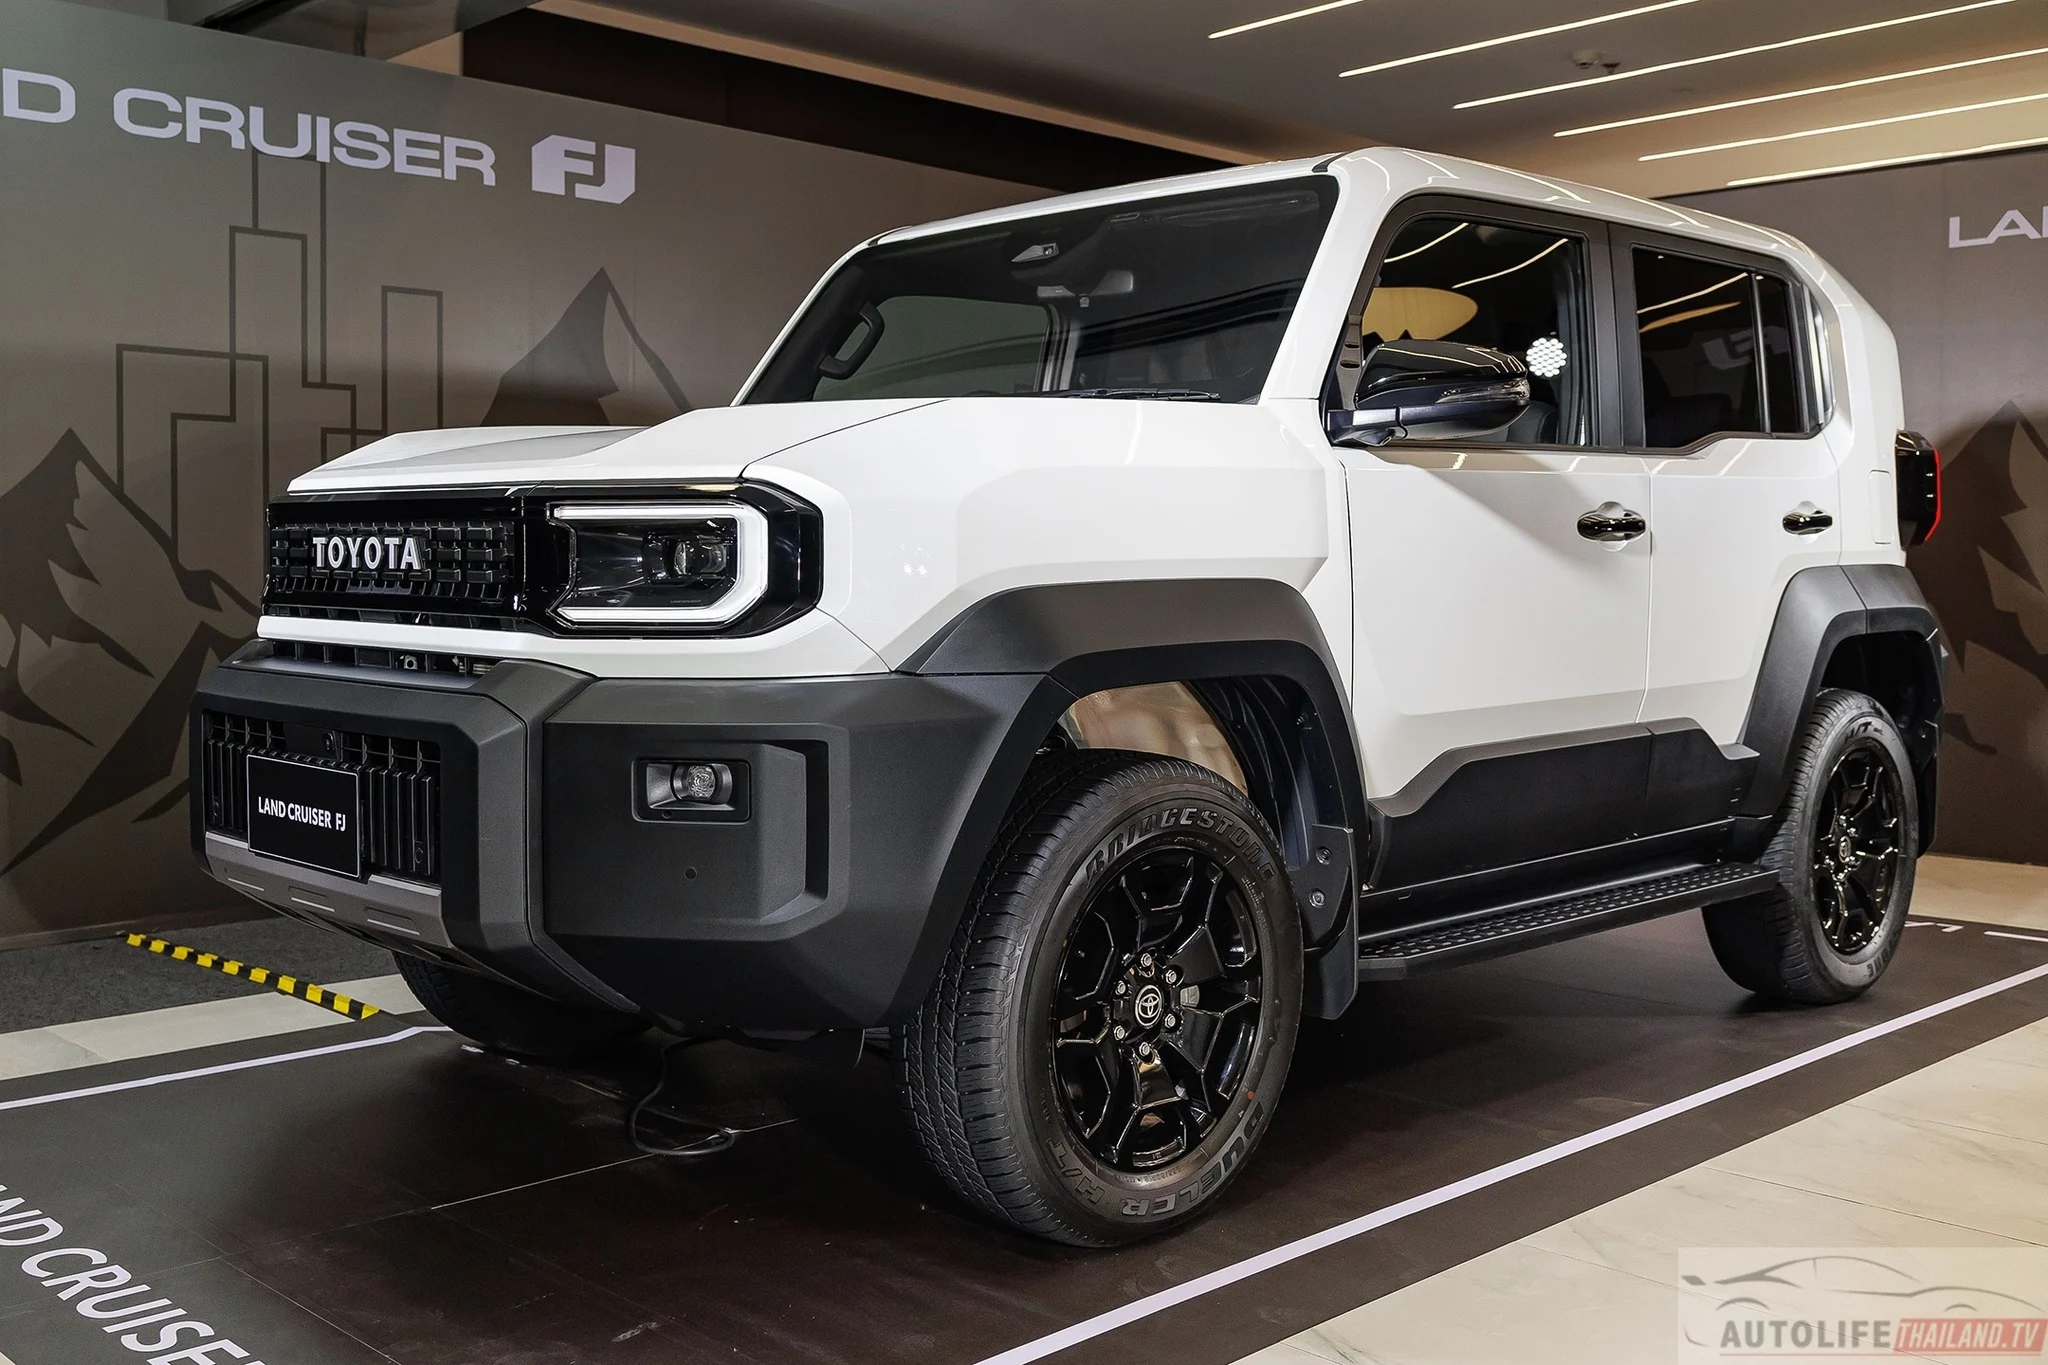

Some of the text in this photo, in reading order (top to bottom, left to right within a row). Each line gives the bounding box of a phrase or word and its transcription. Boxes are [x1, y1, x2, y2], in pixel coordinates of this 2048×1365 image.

[113, 87, 497, 187] CRUISER
[531, 134, 636, 205] FJ
[1948, 205, 2048, 249] LA
[312, 536, 422, 570] TOYOTA
[258, 796, 346, 832] LAND CRUISER FJ
[1085, 806, 1276, 888] BRIDGESTONE
[1048, 1101, 1265, 1217] DUELER H/T
[21, 1247, 270, 1365] CRUISE
